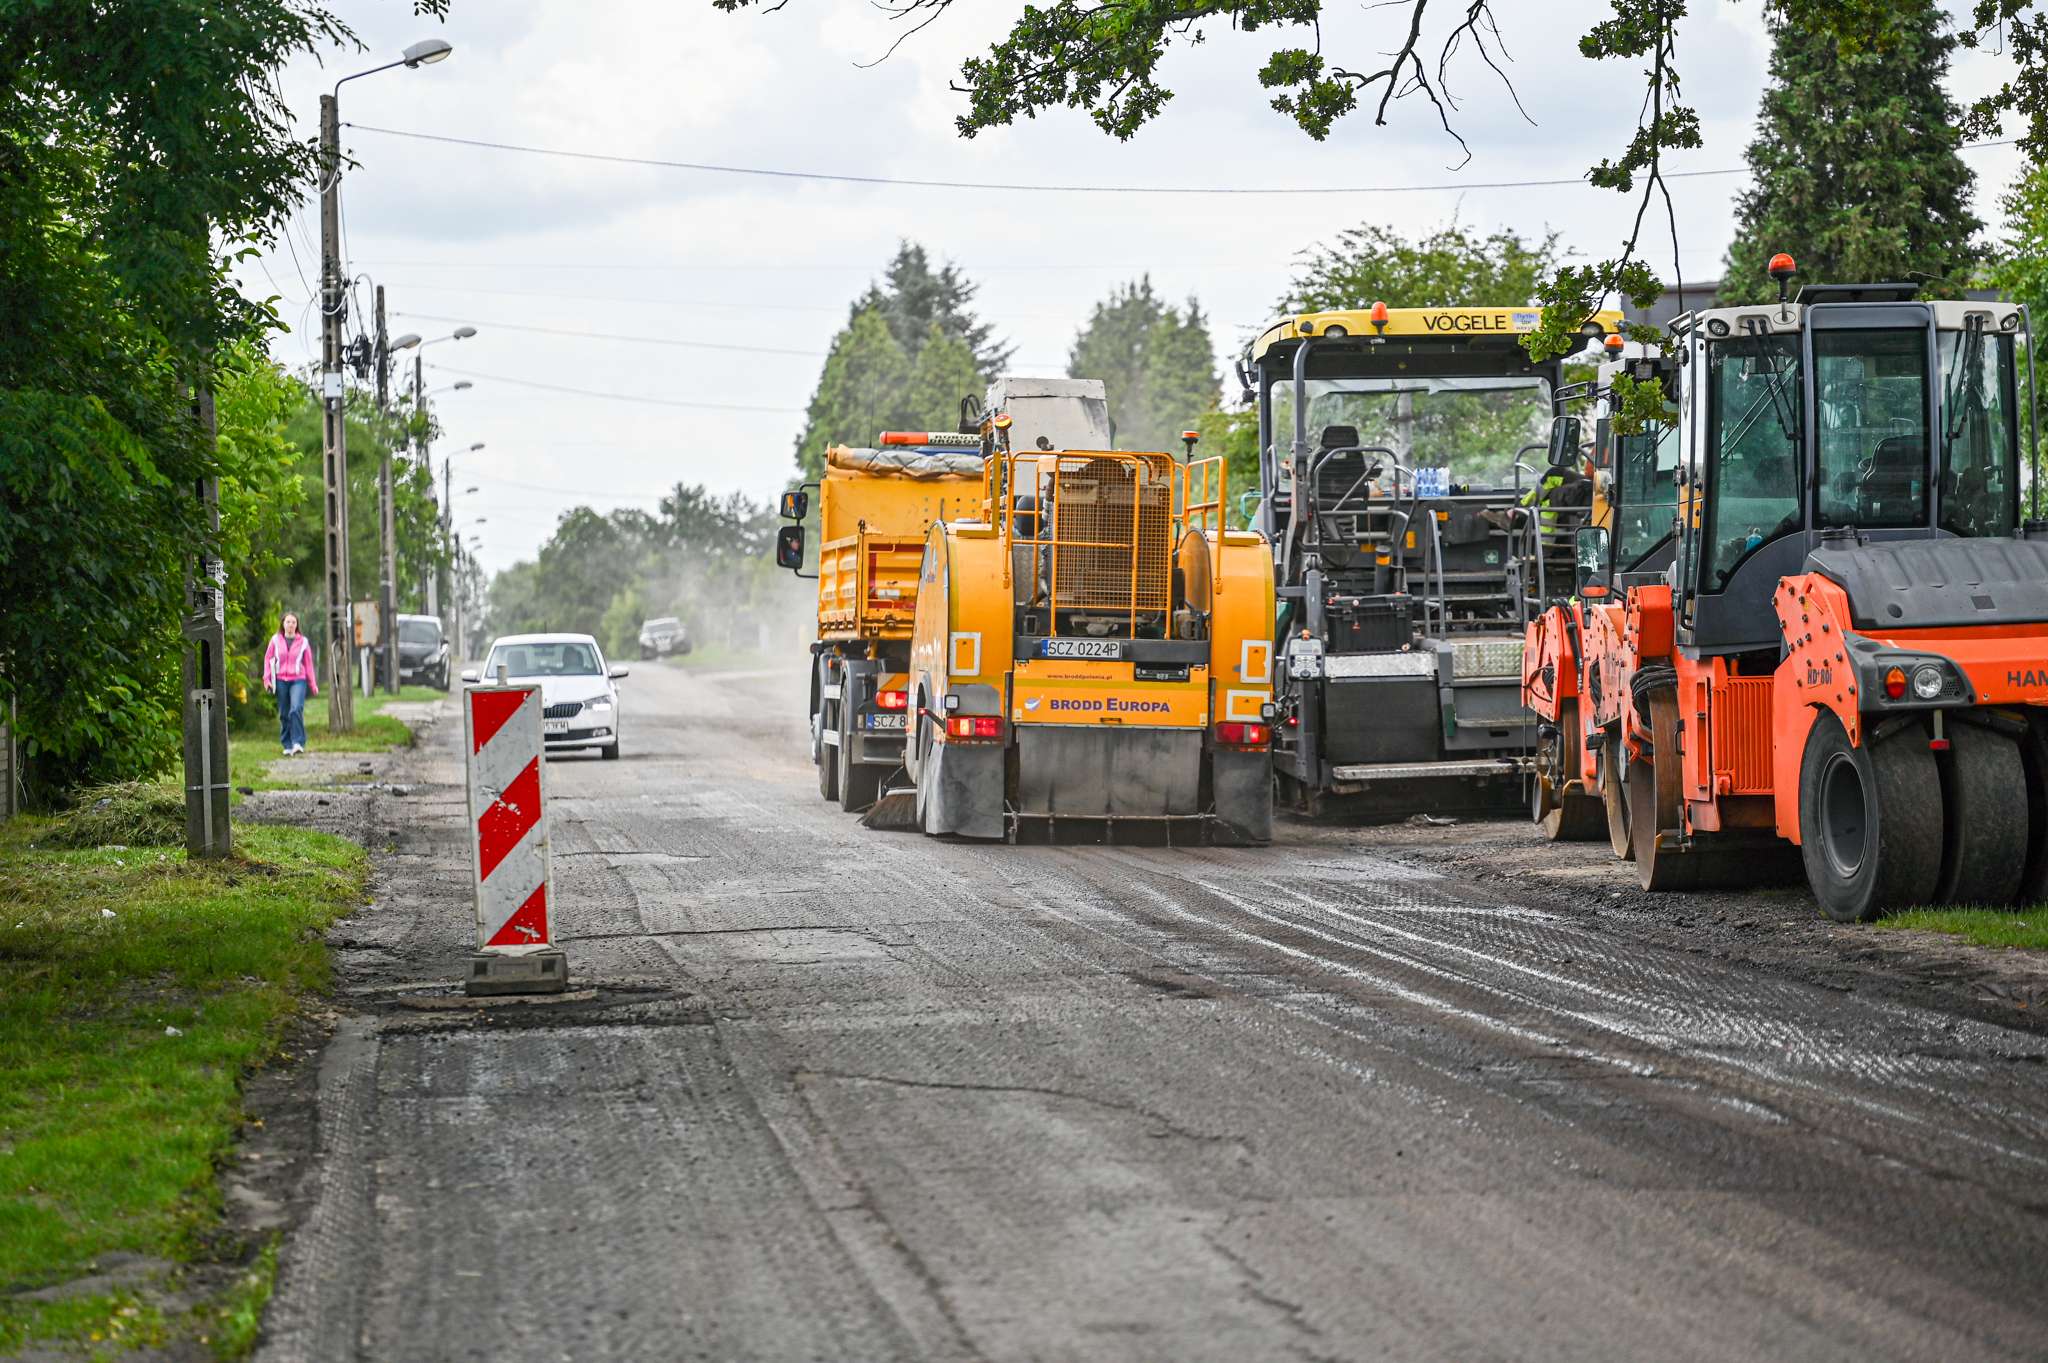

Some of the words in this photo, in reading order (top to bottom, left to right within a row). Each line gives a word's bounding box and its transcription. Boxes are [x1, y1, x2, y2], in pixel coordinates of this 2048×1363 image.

[1423, 312, 1507, 331] VÖGELE
[1048, 642, 1074, 656] SCZ
[1078, 642, 1119, 656] 0224P
[1050, 699, 1103, 711] BRODD
[1106, 698, 1170, 713] EUROPA
[873, 715, 896, 728] SCZ
[900, 715, 906, 728] 8
